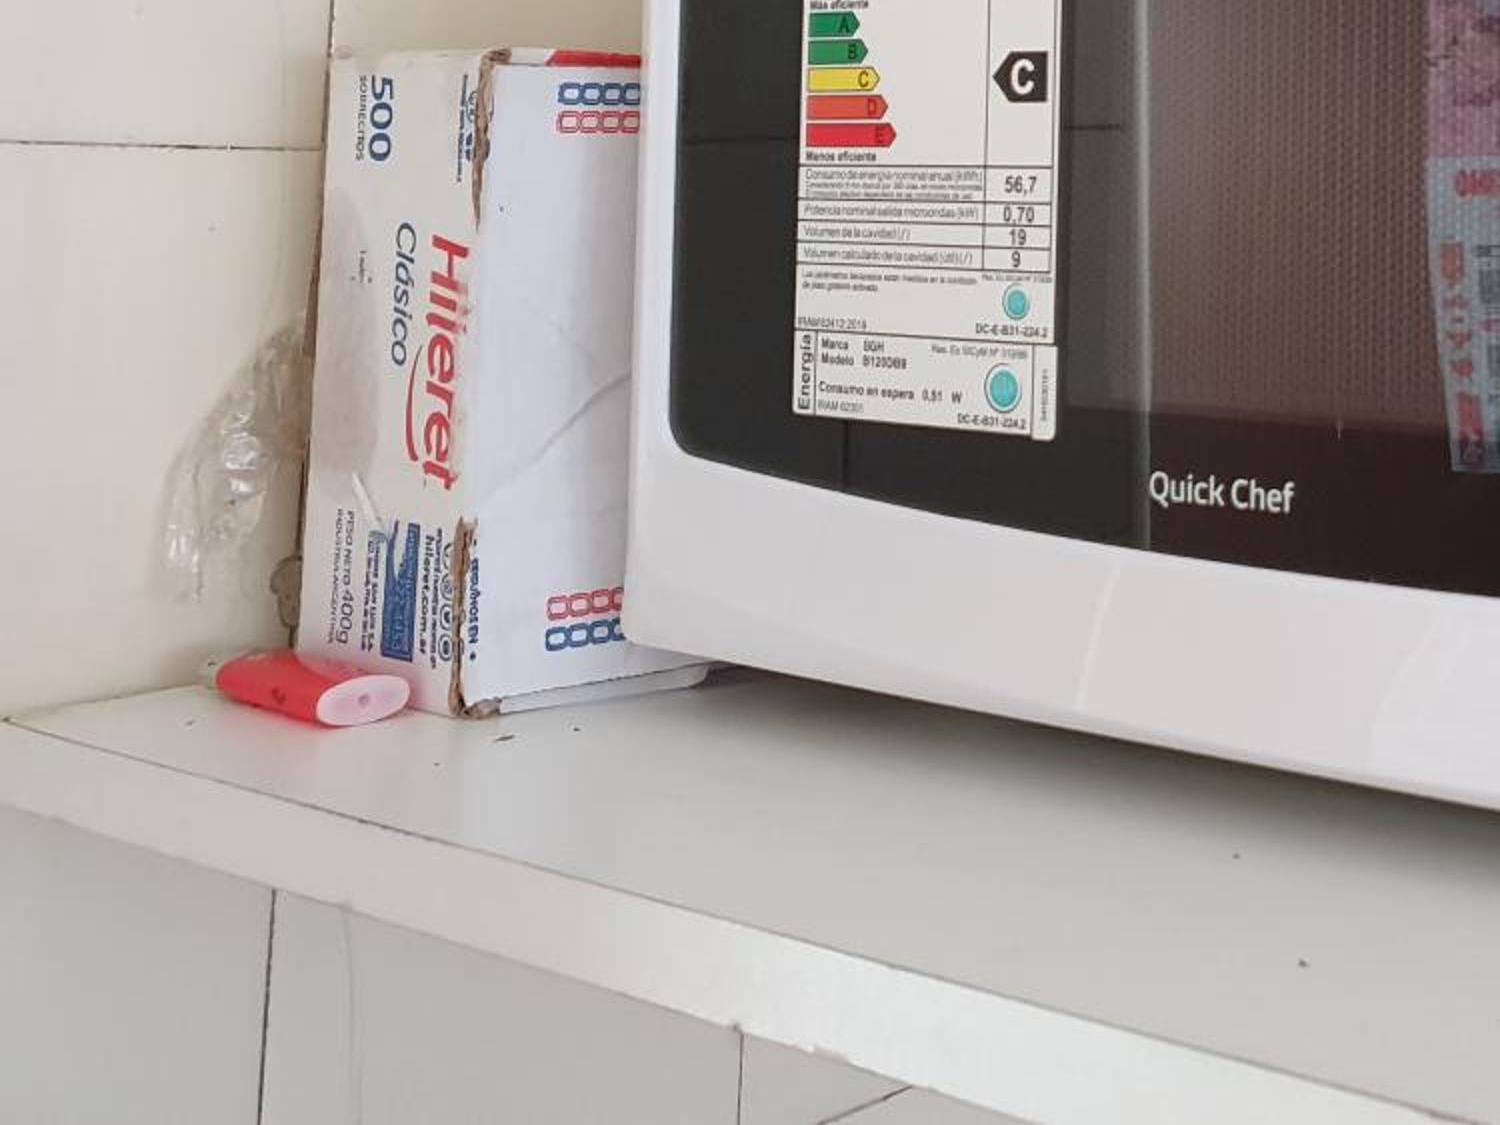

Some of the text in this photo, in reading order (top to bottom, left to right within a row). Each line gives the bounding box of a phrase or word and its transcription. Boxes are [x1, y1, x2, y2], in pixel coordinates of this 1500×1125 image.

[838, 17, 849, 33] A
[848, 43, 857, 60] B
[858, 71, 869, 88] C
[1010, 58, 1035, 95] C
[867, 98, 877, 115] D
[367, 74, 393, 162] 500
[875, 127, 884, 143] E
[1004, 176, 1037, 196] 56,7
[1003, 207, 1035, 225] 0,70
[1009, 229, 1027, 245] 19
[1011, 251, 1021, 267] 9
[390, 222, 416, 367] Clásico
[821, 338, 884, 352] Marca BGH
[423, 234, 470, 491] Hileret
[821, 353, 854, 366] Modelo
[797, 334, 813, 410] Energía
[818, 381, 864, 396] Consumo
[866, 386, 879, 396] en
[881, 387, 915, 401] espera
[951, 391, 962, 403] W
[1150, 470, 1296, 514] Quick Chef
[336, 589, 355, 644] 400g
